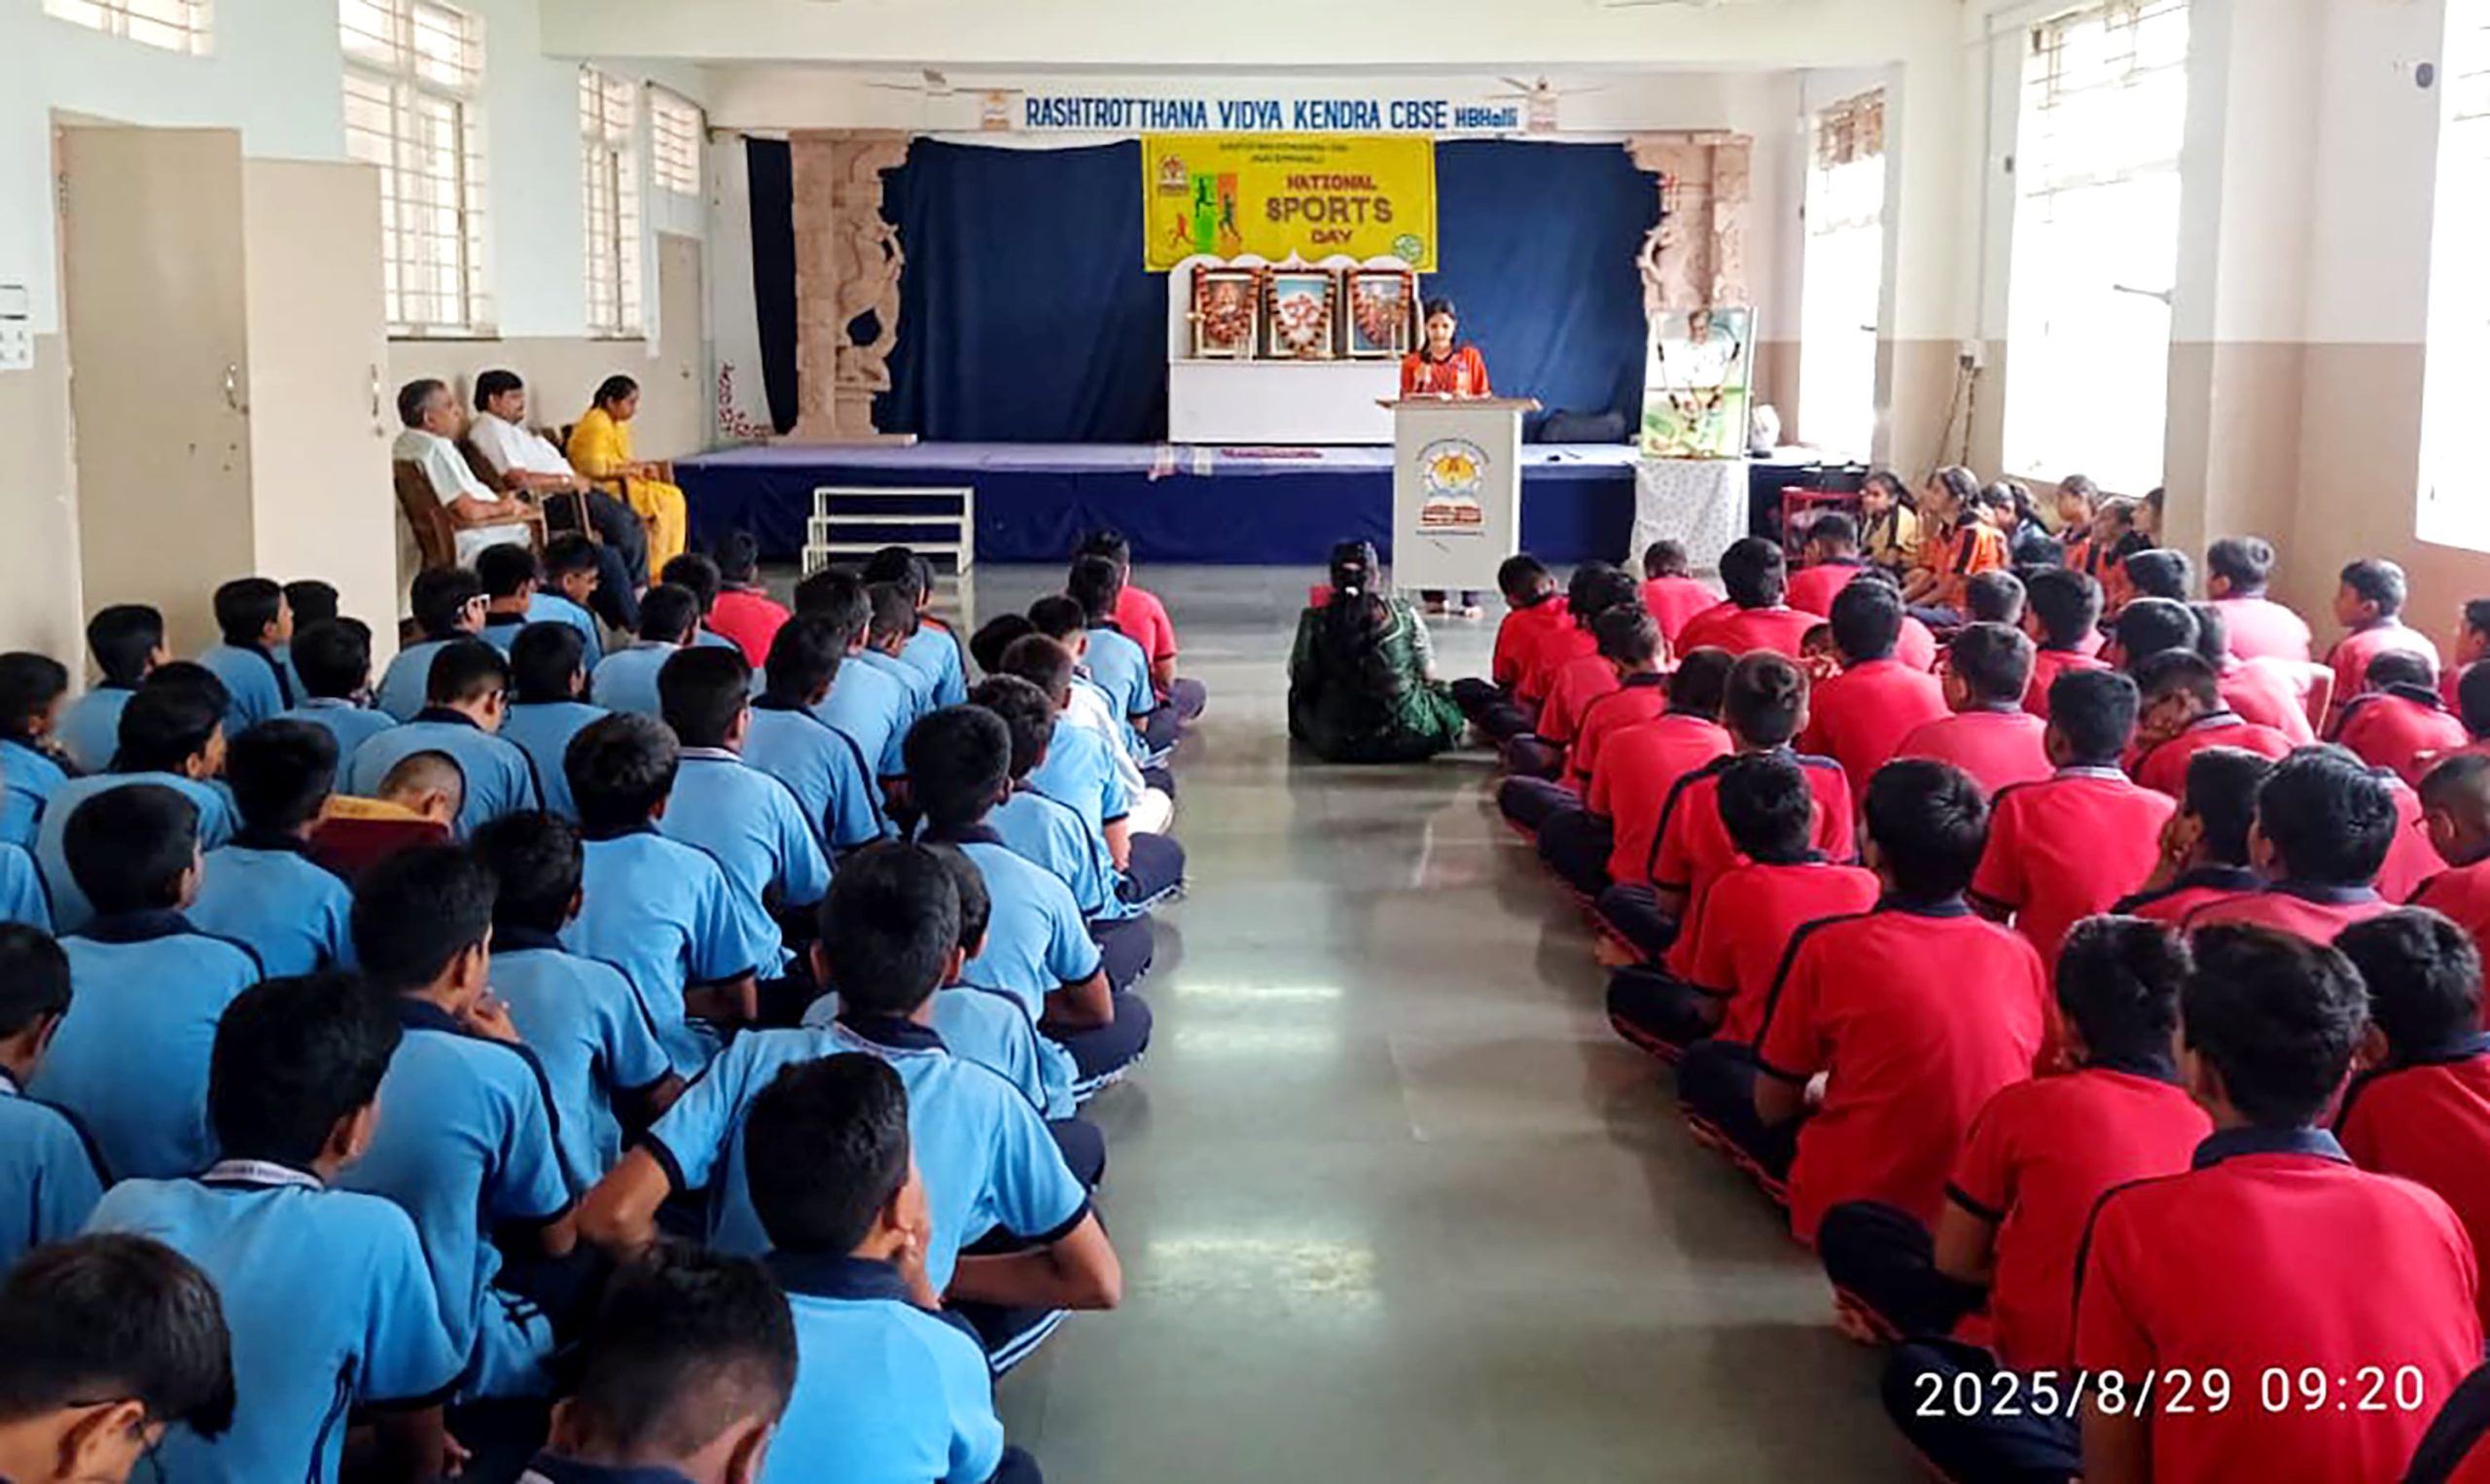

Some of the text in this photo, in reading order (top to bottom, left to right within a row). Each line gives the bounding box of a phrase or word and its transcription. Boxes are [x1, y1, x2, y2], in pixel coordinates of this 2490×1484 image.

[1026, 97, 1207, 128] RASHTROTTHANA
[1218, 100, 1282, 129] VIDYA
[1294, 100, 1380, 129] KENDRA
[1390, 100, 1447, 128] CBSE
[1286, 174, 1377, 191] NATIONAL
[1265, 195, 1393, 224] SPORTS
[1310, 229, 1353, 244] DAY
